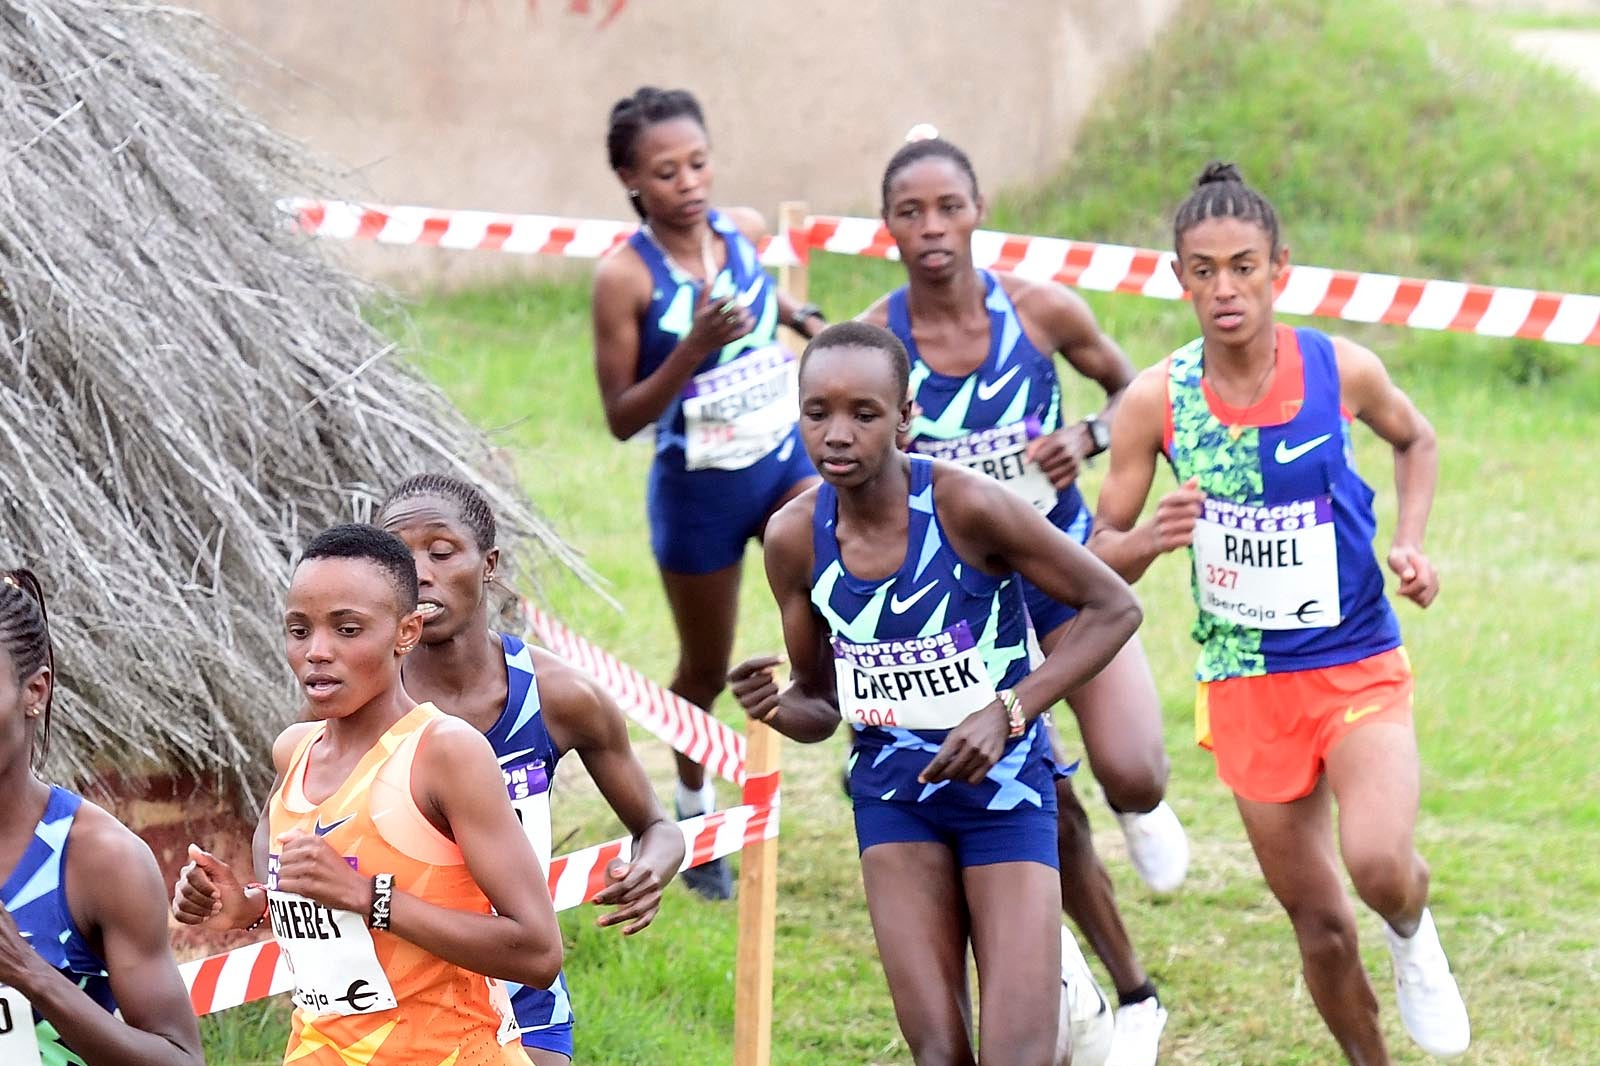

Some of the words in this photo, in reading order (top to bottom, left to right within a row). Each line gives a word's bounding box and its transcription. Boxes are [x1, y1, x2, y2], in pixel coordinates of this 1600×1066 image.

[969, 451, 1025, 480] BET
[1224, 533, 1303, 568] RAHEL
[1206, 564, 1238, 589] 327
[855, 708, 897, 727] 304
